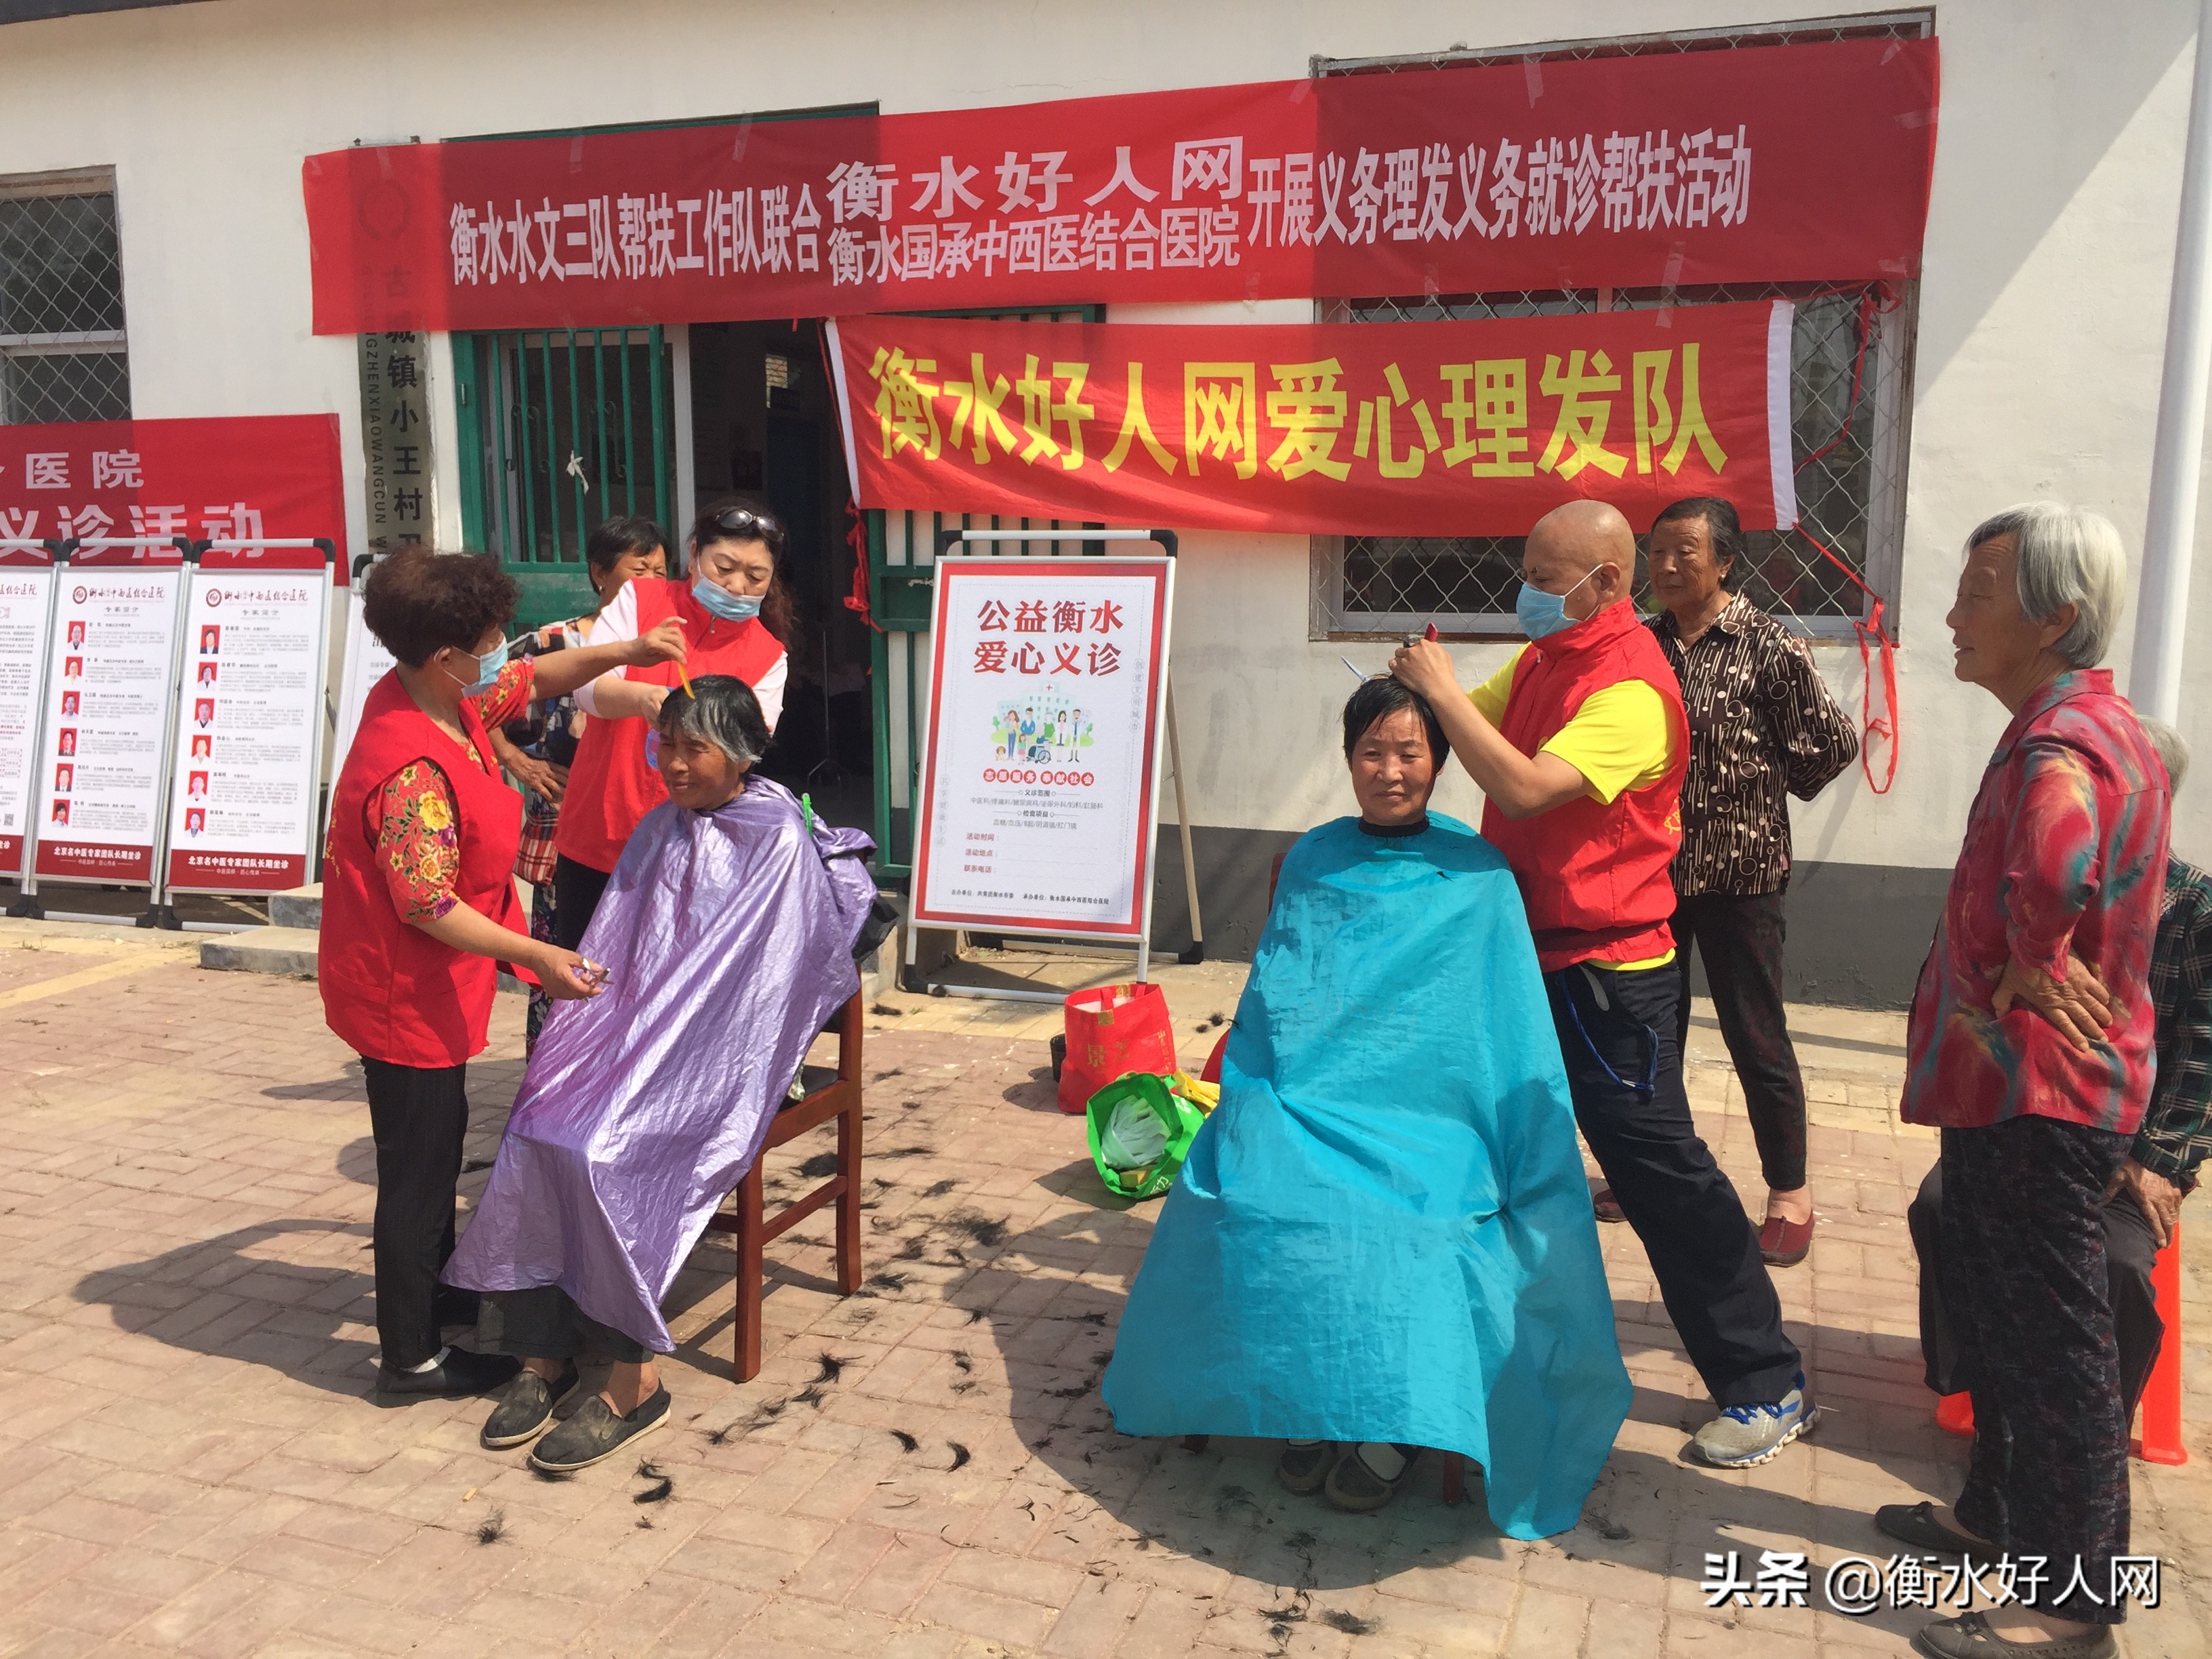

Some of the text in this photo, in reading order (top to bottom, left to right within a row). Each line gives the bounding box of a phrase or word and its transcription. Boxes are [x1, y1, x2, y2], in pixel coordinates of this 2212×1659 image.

[826, 136, 1243, 223] 衡水好人网
[1248, 125, 1753, 247] 开展义务理发义务就诊帮扶活动
[450, 183, 821, 285] 衡水水文三队帮扶工作队联合
[828, 204, 1240, 286] 衡水国承中西医结合医院
[869, 342, 1729, 481] 衡水好人网爱心理发队
[973, 640, 1122, 676] 爱心义诊
[977, 599, 1124, 634] 公益衡水
